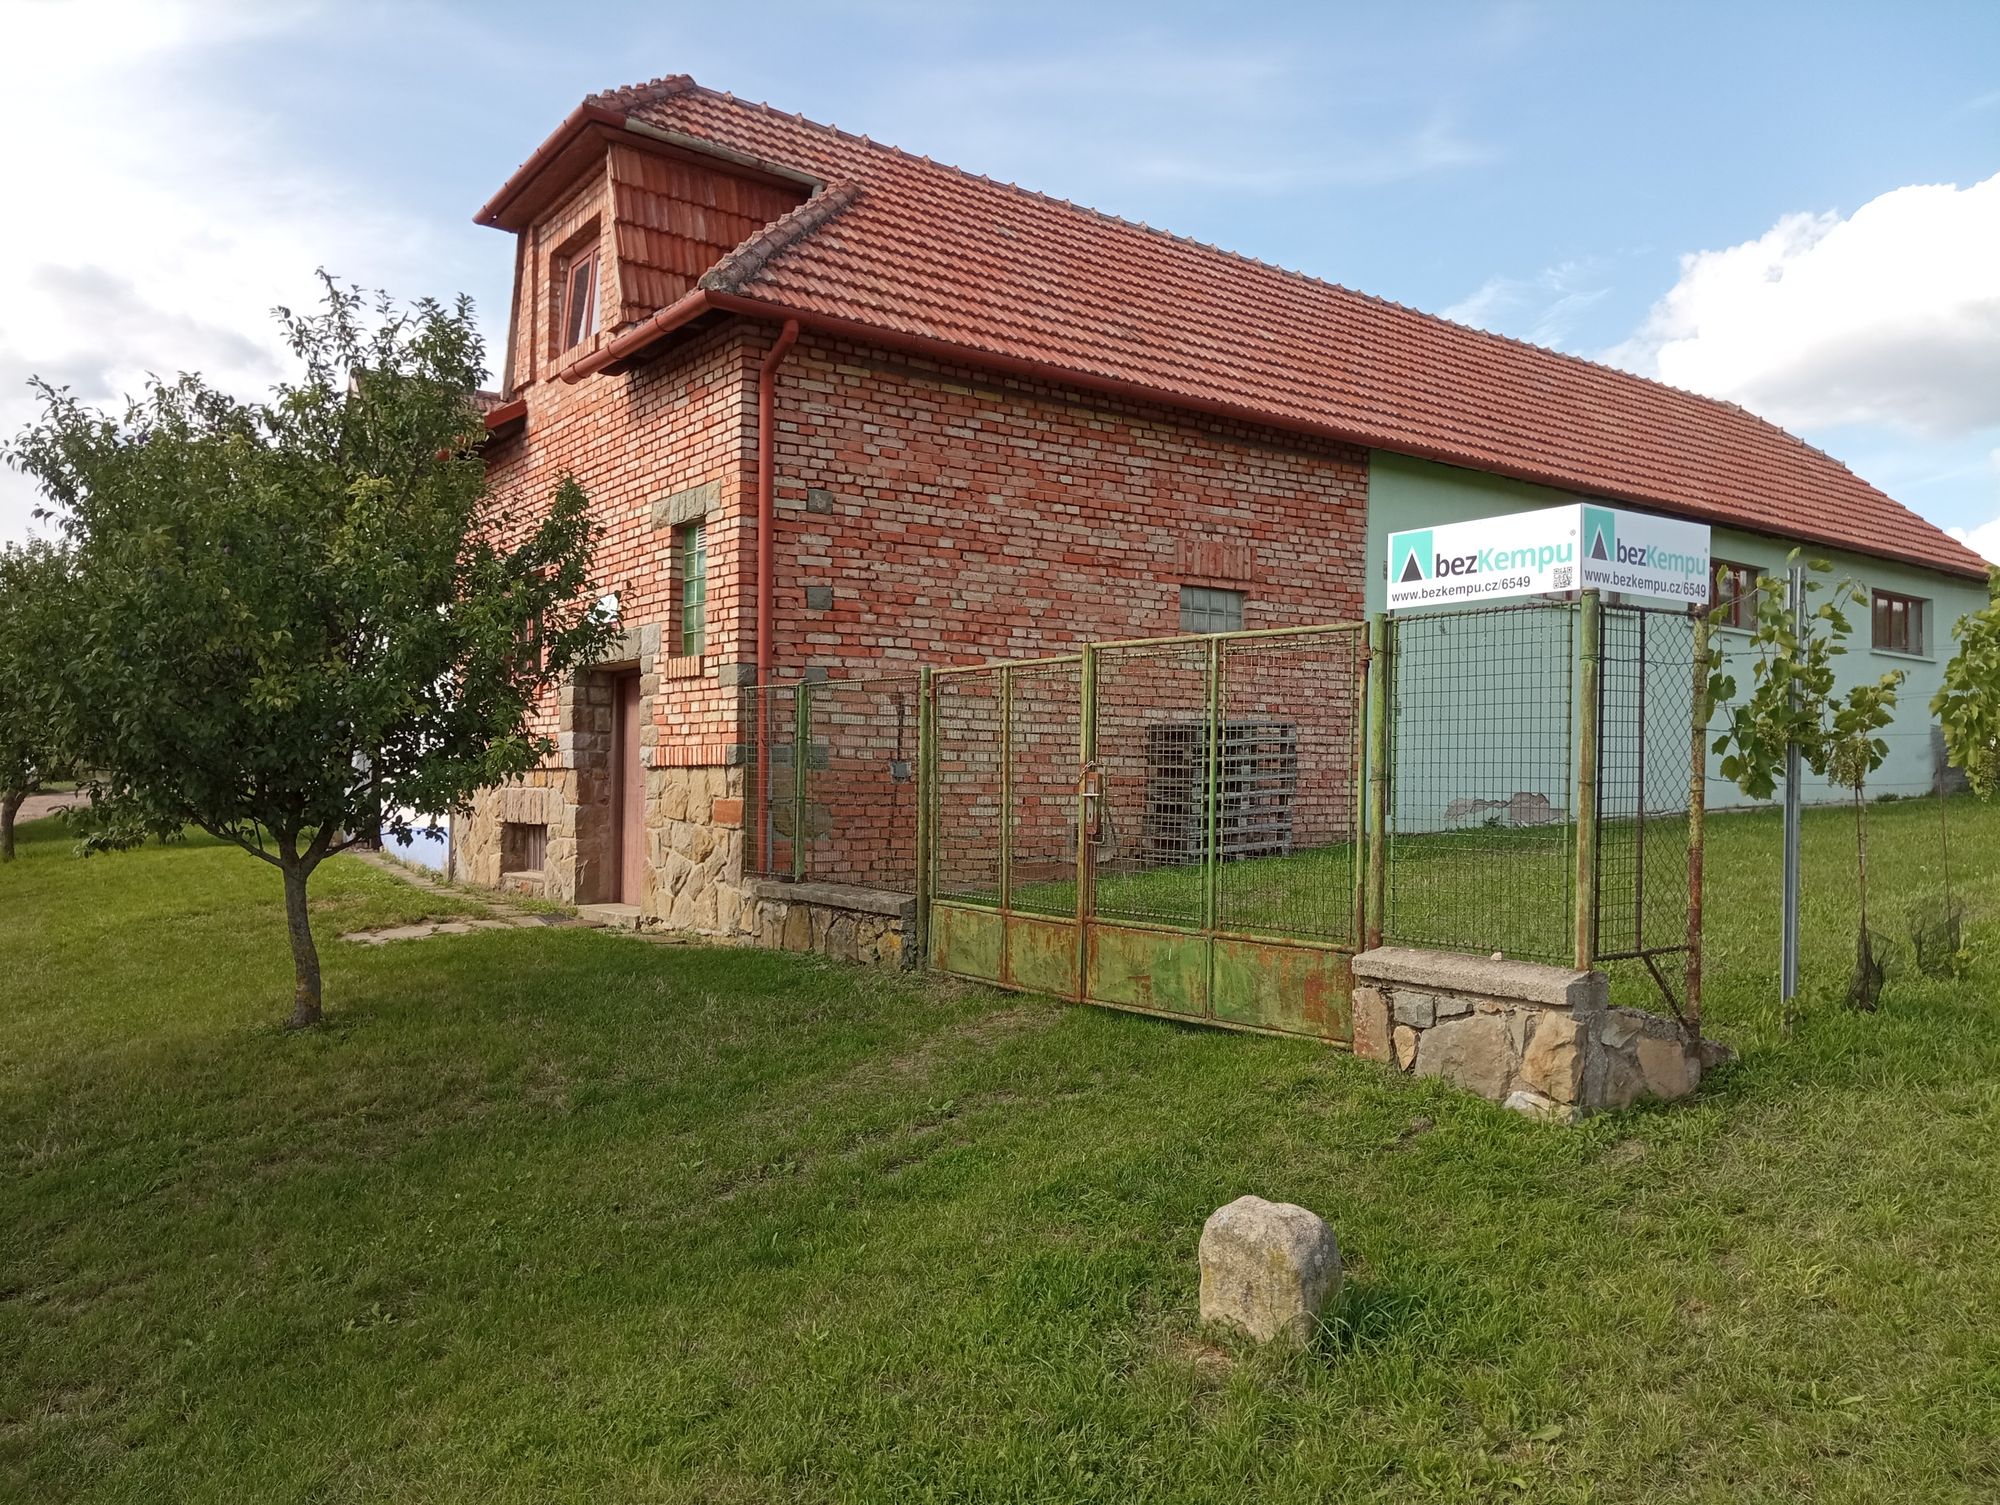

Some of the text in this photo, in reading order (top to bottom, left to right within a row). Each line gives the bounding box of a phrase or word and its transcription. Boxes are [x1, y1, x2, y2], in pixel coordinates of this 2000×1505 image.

[1435, 542, 1572, 578] bezKempu
[1616, 538, 1706, 579] bezKempu
[1391, 575, 1531, 602] www.bezkempu.cz/6549
[1584, 569, 1706, 598] www.bezkempu.cz/6549
